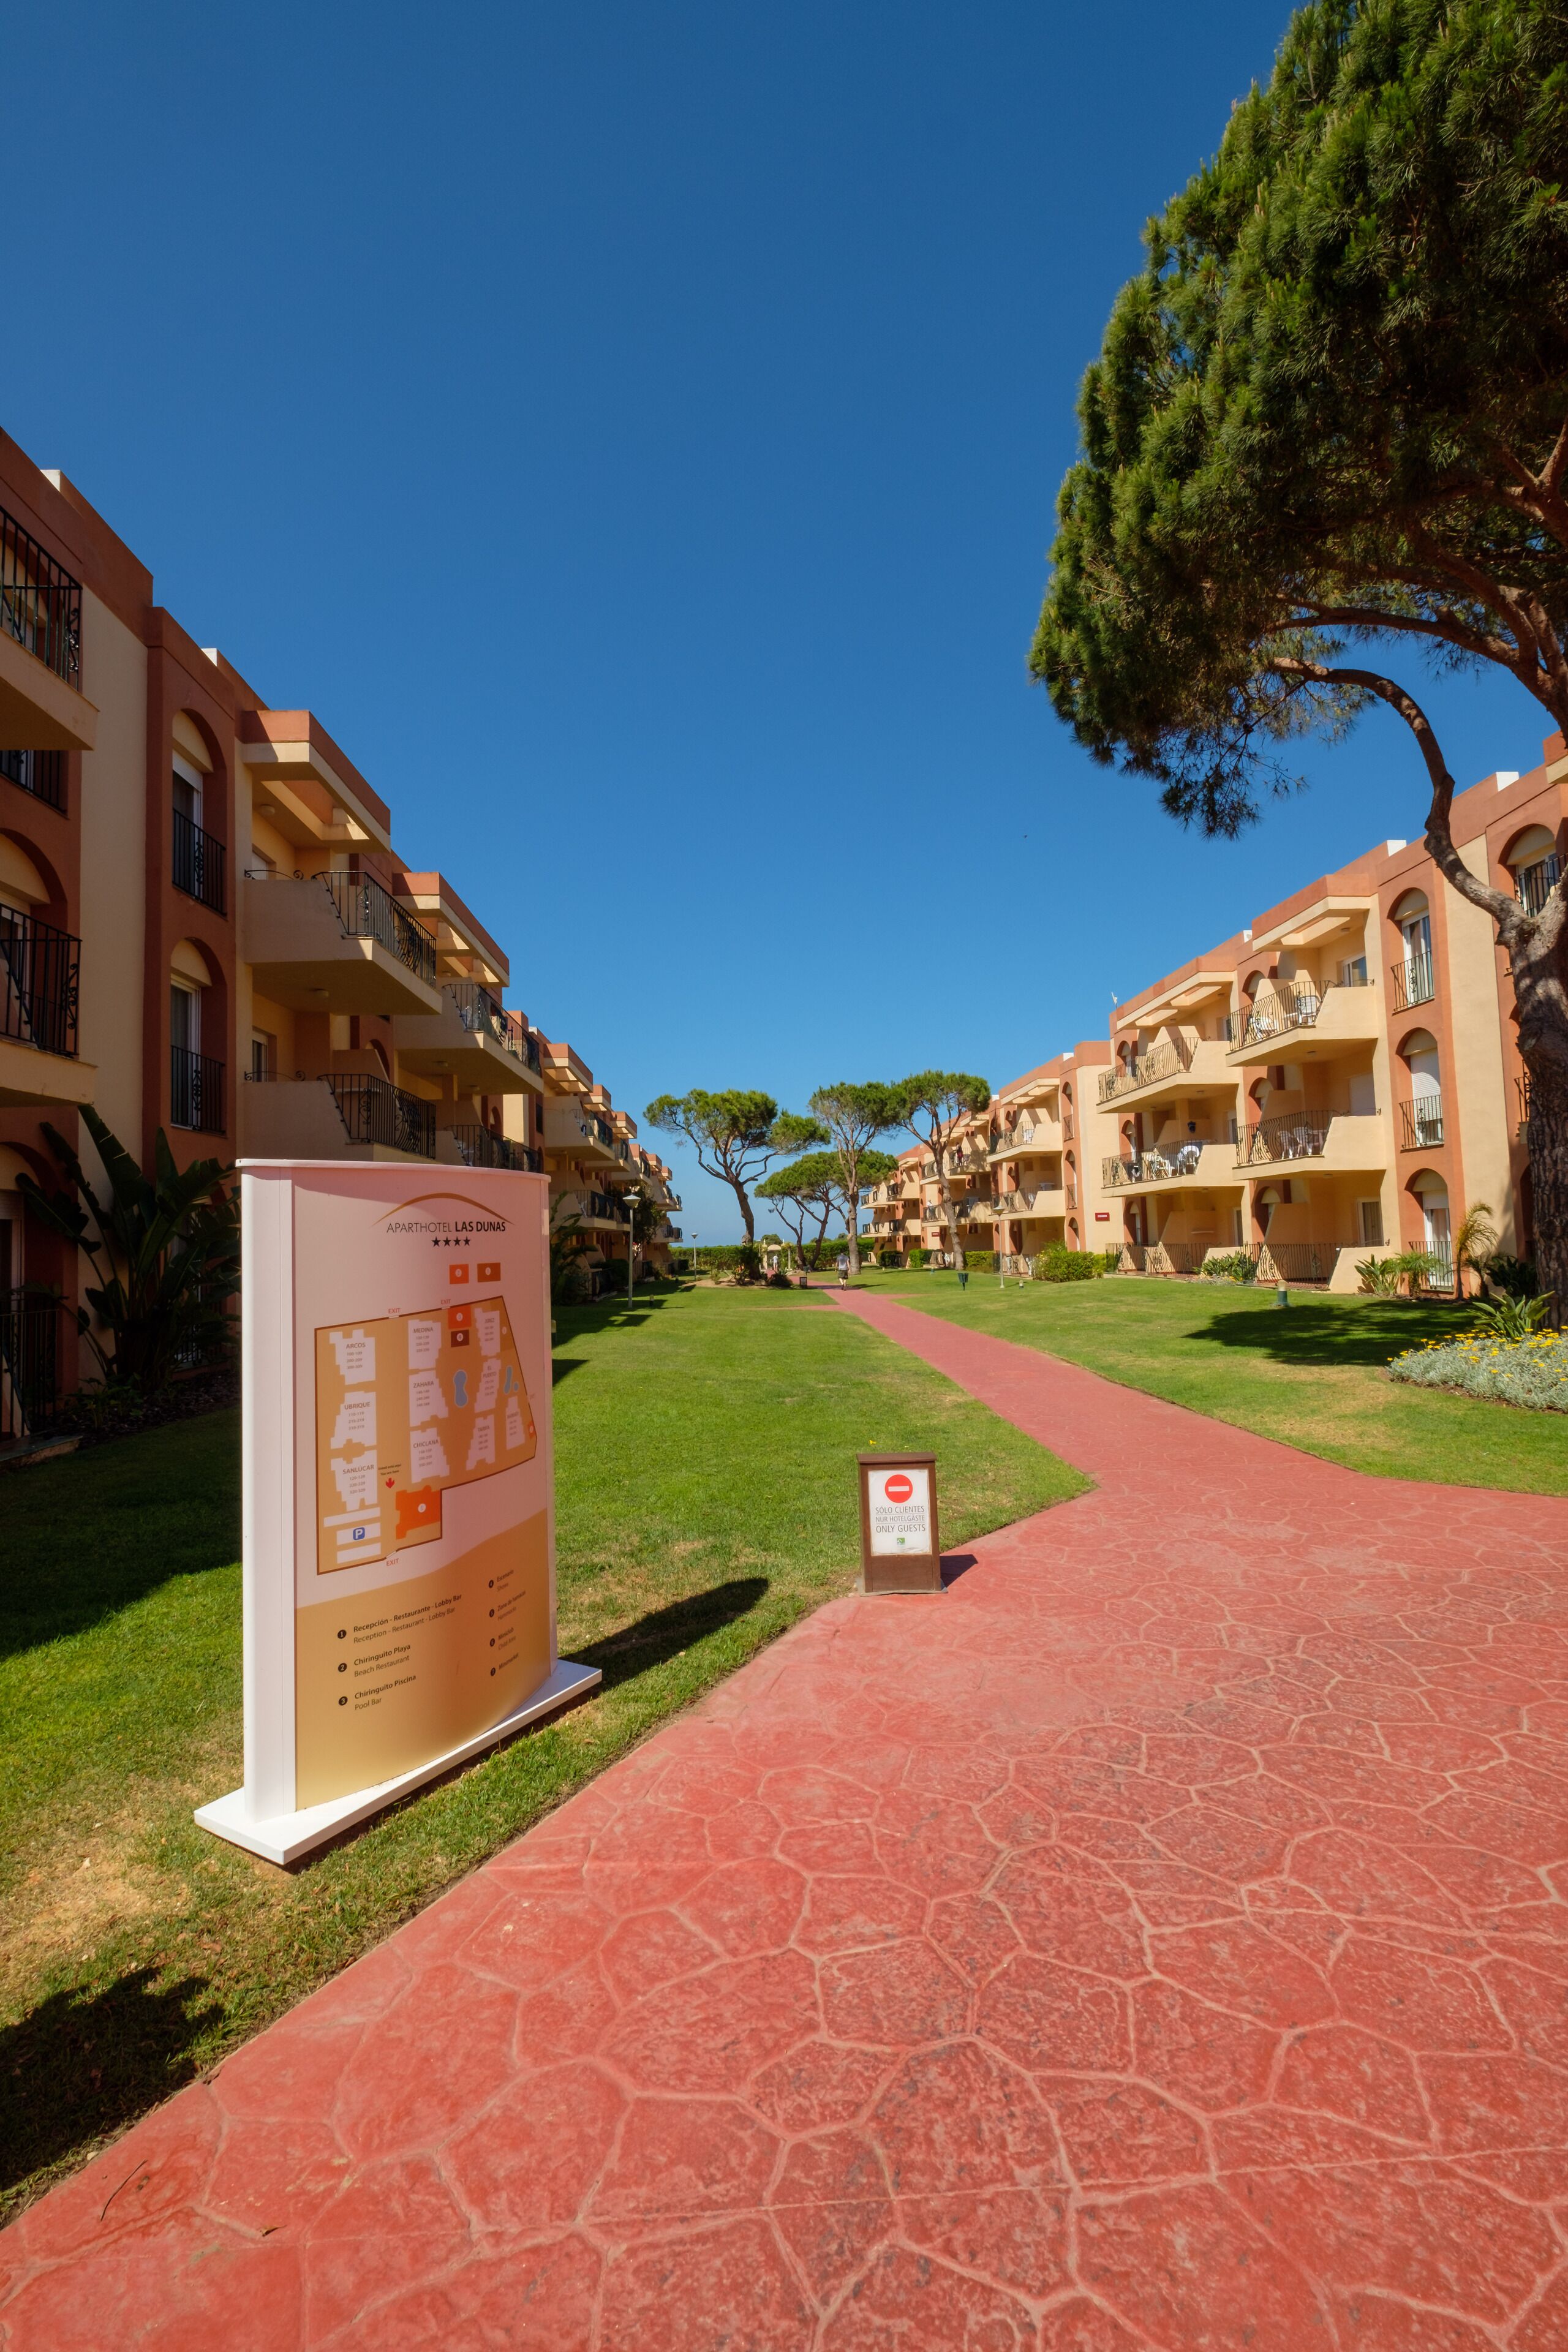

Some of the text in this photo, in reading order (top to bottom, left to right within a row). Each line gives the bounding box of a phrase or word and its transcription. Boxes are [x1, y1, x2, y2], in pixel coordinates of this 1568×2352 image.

[386, 1221, 506, 1233] APARTHOTEL LAS DUNAS
[344, 1401, 371, 1410] UBRIQUE
[413, 1439, 439, 1449] CHICLANA
[875, 1506, 892, 1514] SÓLO
[355, 1528, 363, 1539] P
[353, 1618, 388, 1632] Recepción
[394, 1605, 431, 1621] Restaurante
[435, 1597, 452, 1608] Lobby
[353, 1630, 387, 1643] Reception
[392, 1618, 424, 1632] Restaurant
[429, 1610, 445, 1621] Lobby
[447, 1607, 456, 1615] Bar
[354, 1650, 392, 1665] Chiringuito
[394, 1645, 410, 1654] Playa
[354, 1655, 410, 1677] Beach Restaurant
[355, 1683, 393, 1699] Chiringuito
[394, 1675, 417, 1687] Piscina
[355, 1700, 369, 1710] Pool
